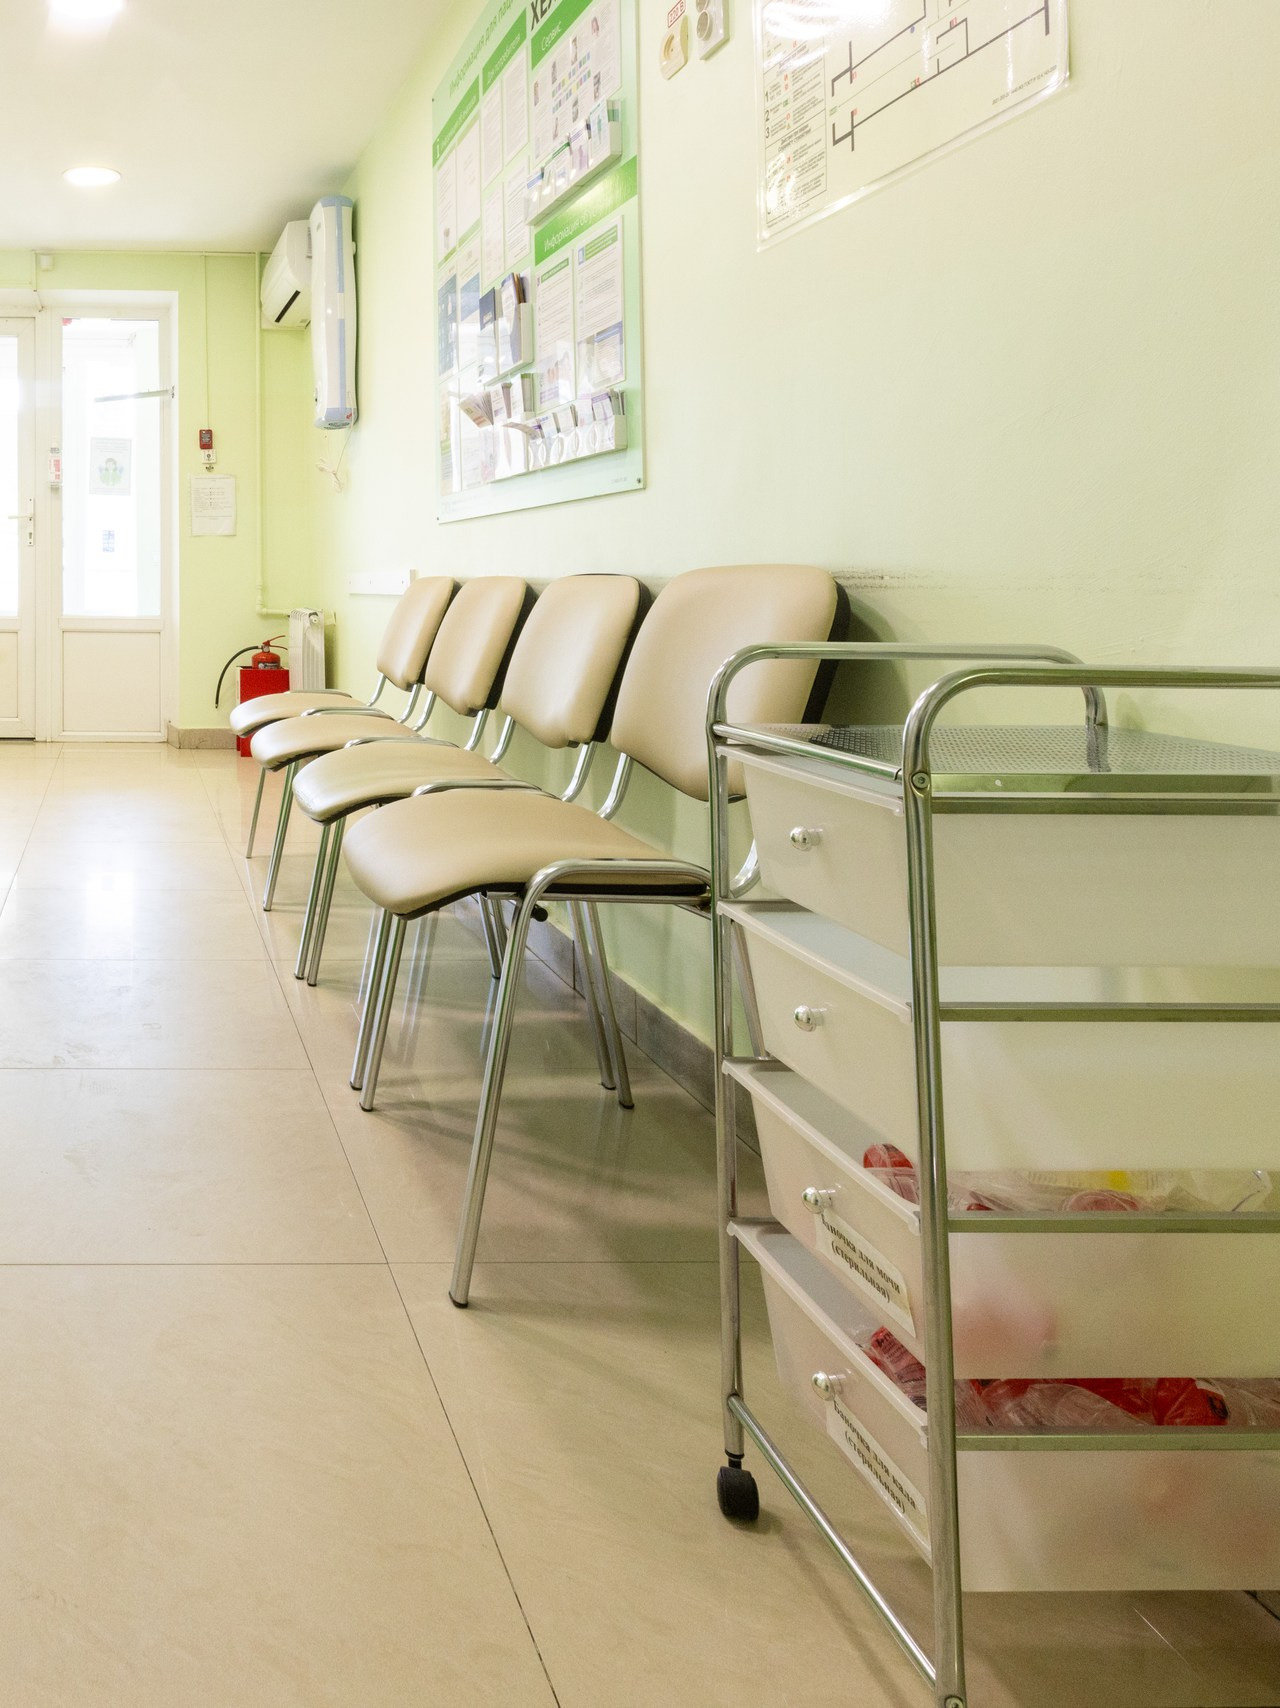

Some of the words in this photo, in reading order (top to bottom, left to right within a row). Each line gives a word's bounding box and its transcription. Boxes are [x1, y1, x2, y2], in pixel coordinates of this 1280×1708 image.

[543, 217, 580, 253] Информация
[831, 1240, 891, 1304] (стерильная)
[858, 1249, 875, 1270] для
[876, 1265, 901, 1294] мочи
[833, 1399, 871, 1453] Баночка
[872, 1450, 890, 1477] для
[891, 1474, 917, 1511] кала
[844, 1430, 906, 1515] (стерильная)
